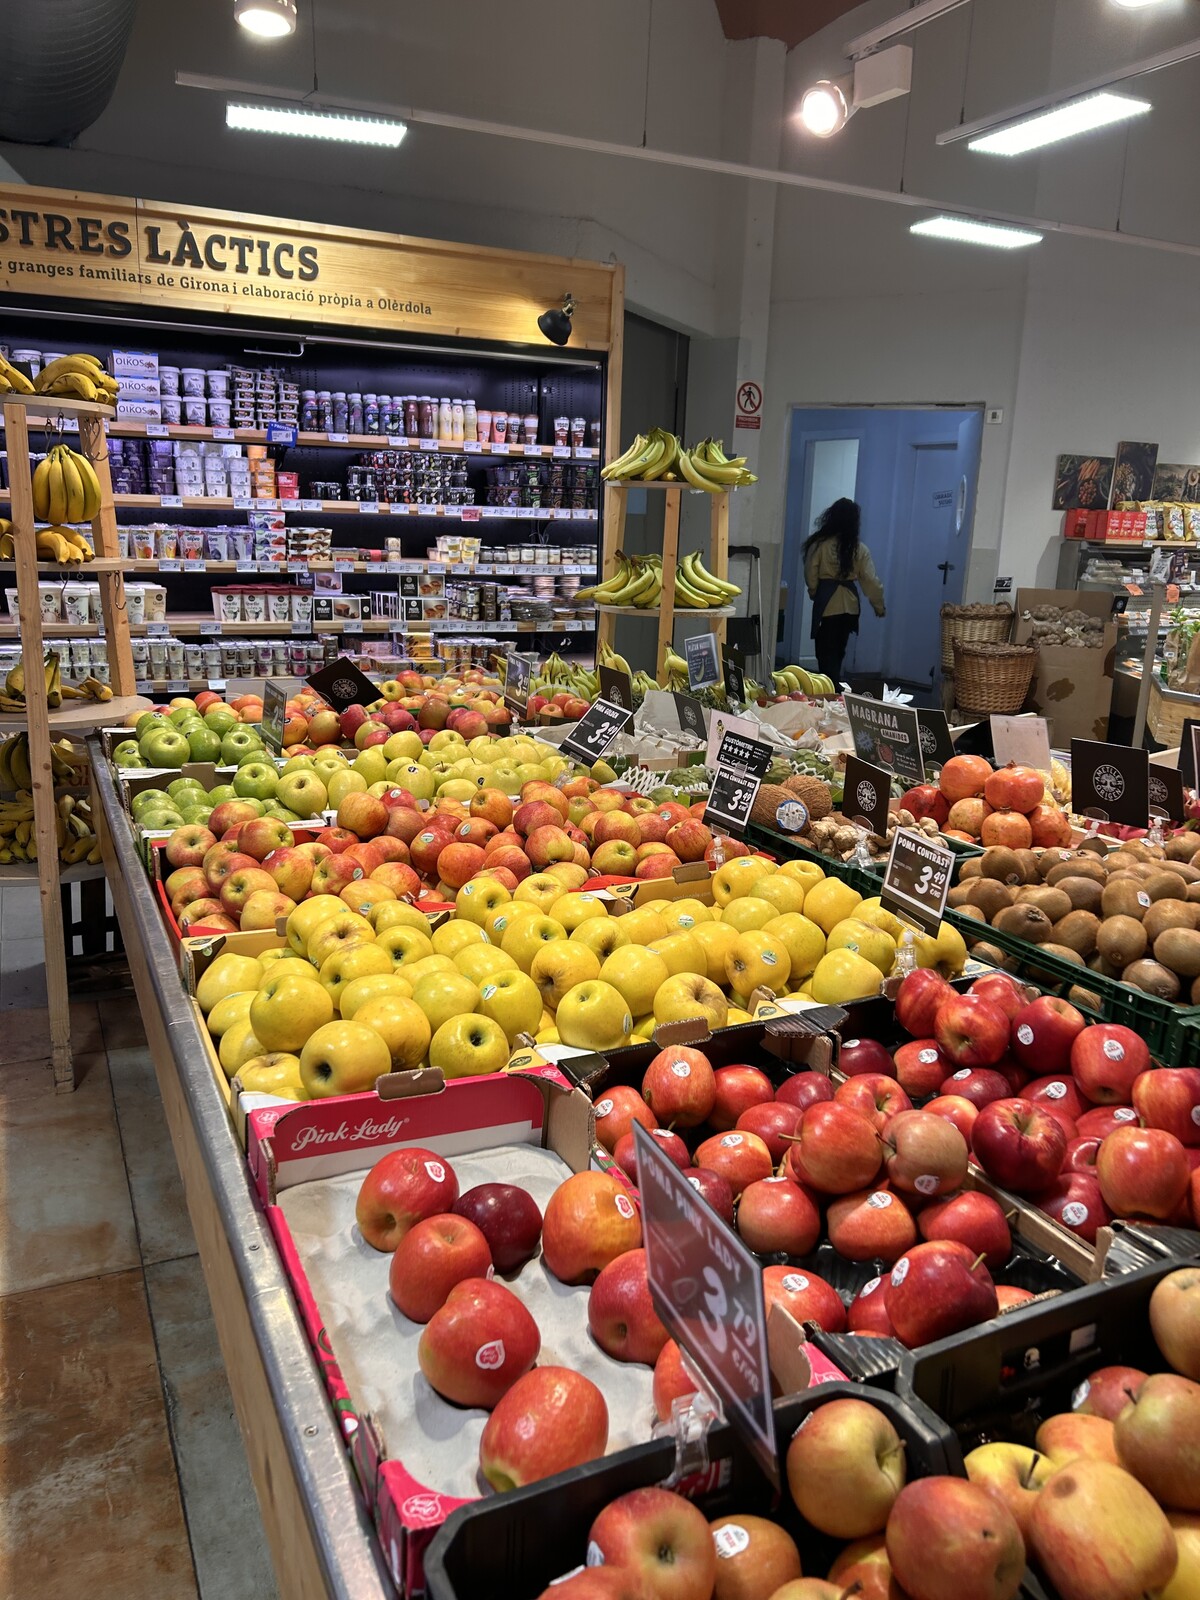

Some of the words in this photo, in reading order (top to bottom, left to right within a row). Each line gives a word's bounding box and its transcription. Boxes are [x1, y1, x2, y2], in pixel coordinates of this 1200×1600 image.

[144, 218, 320, 282] LÀCTICS
[8, 259, 74, 277] granges
[79, 264, 152, 285] familiars
[157, 273, 175, 287] de
[180, 276, 229, 293] Girona
[233, 282, 238, 295] i
[242, 284, 314, 302] elaboració
[319, 292, 362, 308] pròpia
[366, 300, 374, 309] a
[378, 298, 432, 315] Olèrdola
[115, 357, 144, 367] OIKOS
[119, 381, 146, 391] OIKOS
[119, 405, 147, 414] OIKOS
[851, 704, 898, 729] MAGRANA
[587, 721, 611, 744] 3
[719, 770, 730, 780] POMA
[1094, 766, 1123, 786] AMETLLER
[727, 788, 743, 811] 3
[742, 792, 752, 802] 49
[1096, 784, 1122, 799] ORIGEN
[897, 836, 916, 852] POMA
[916, 846, 949, 868] CONTRAST
[914, 865, 933, 894] 3
[933, 871, 946, 885] 49
[290, 1121, 350, 1151] Pink
[640, 1144, 673, 1201] POMA
[676, 1192, 704, 1238] PINK
[706, 1224, 742, 1284] LADY
[698, 1265, 728, 1355] 3
